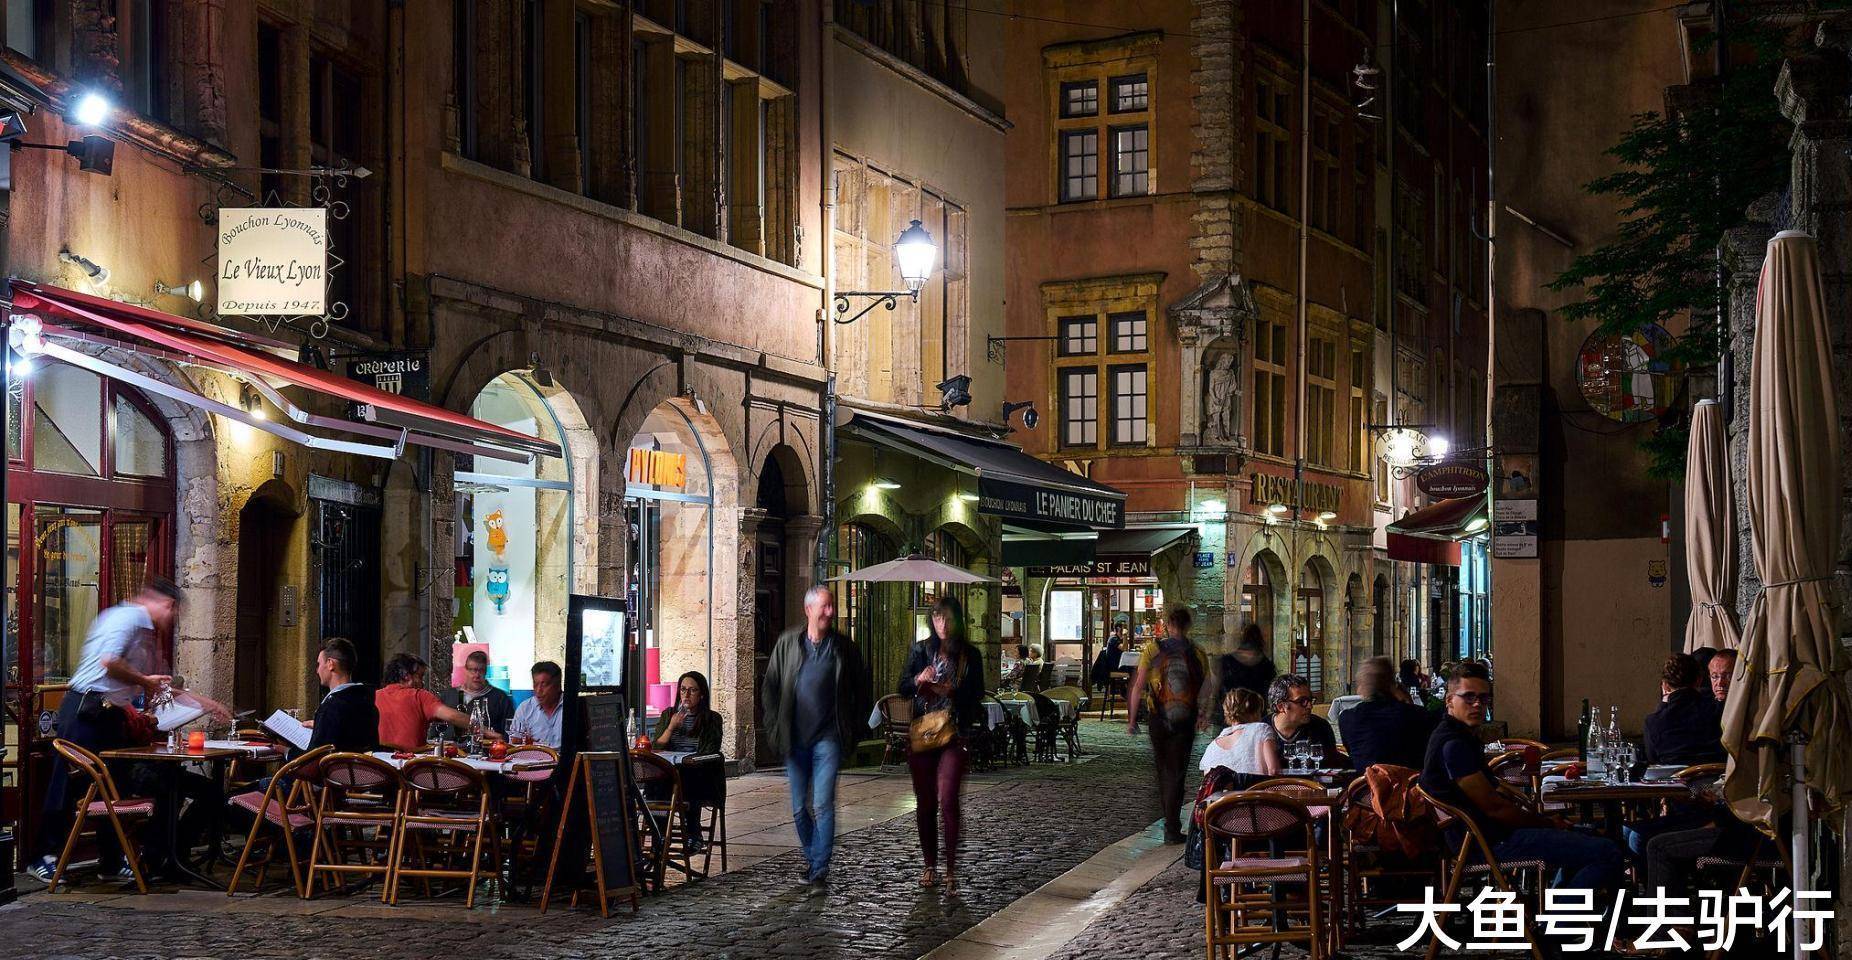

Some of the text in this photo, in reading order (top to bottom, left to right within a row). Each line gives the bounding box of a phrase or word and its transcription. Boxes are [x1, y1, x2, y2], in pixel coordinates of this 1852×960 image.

[221, 214, 324, 246] Bouchon Lyonnais
[222, 257, 321, 287] Le Vieux Lyon
[222, 300, 277, 313] Depuis
[1036, 491, 1117, 524] LE PANIER DU CHEF
[1256, 473, 1345, 512] RESTAURANT
[1096, 562, 1112, 573] ST
[1116, 562, 1147, 573] JEAN
